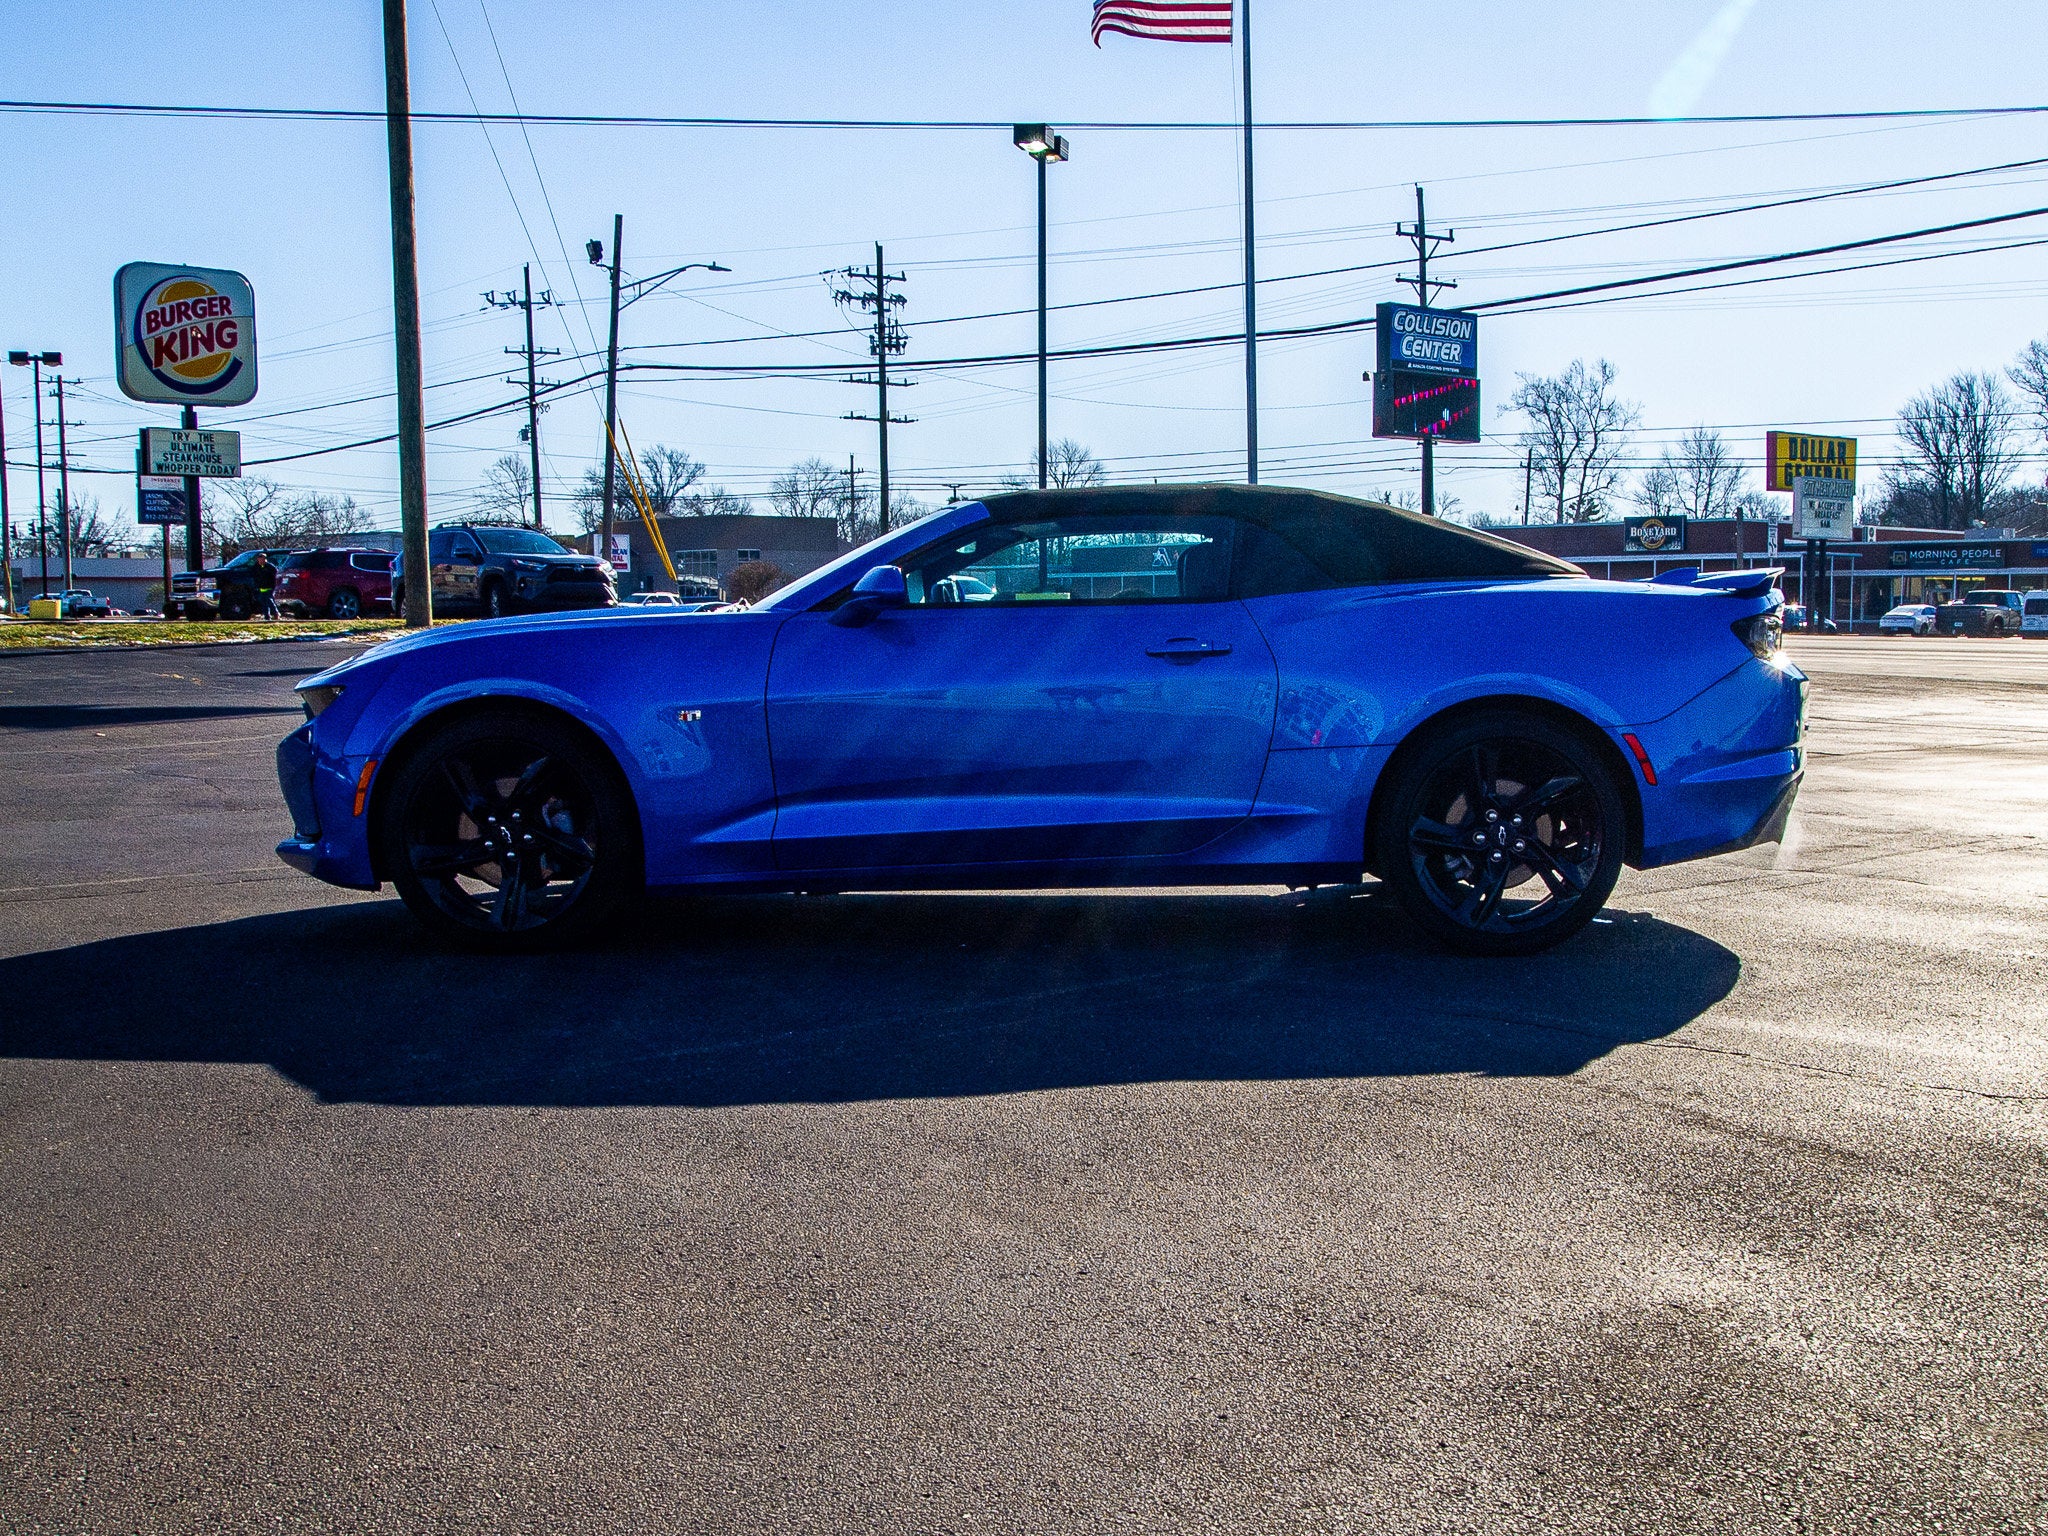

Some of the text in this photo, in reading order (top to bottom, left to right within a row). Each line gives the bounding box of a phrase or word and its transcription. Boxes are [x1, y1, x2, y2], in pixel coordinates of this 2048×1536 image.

[145, 295, 233, 335] BURGER
[1393, 310, 1472, 339] COLLISION
[152, 319, 239, 368] KING
[1401, 335, 1461, 362] CENTER
[172, 432, 214, 442] TRY THE
[162, 452, 222, 464] STEAKHOUSE
[170, 443, 215, 453] ULTIMATE
[1788, 437, 1847, 465] DOLLAR
[156, 462, 236, 475] WHOPPER TODAY
[1909, 549, 2001, 559] MORNING PEOPLE
